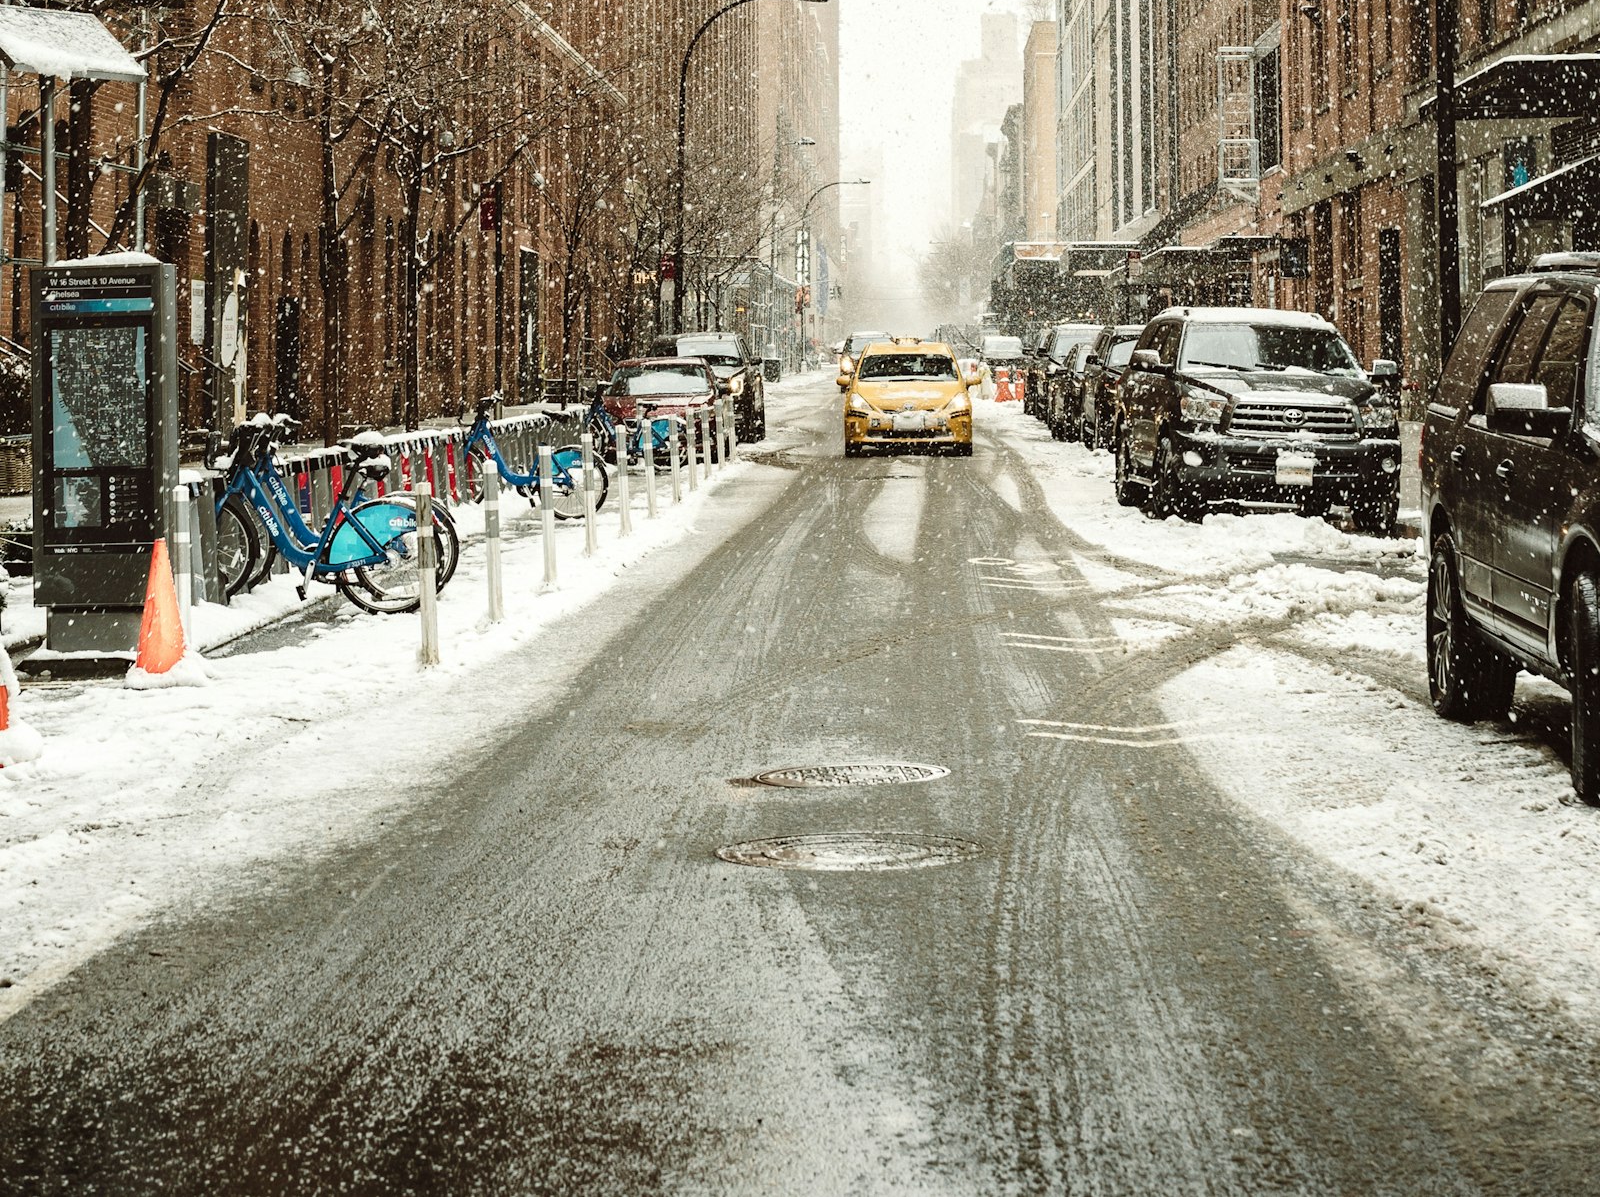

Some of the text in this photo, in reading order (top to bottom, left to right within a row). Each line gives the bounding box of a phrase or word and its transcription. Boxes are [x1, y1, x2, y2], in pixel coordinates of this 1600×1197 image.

[797, 231, 809, 285] PARK
[68, 278, 91, 286] Street
[108, 277, 136, 285] Avenue
[49, 290, 80, 298] Chelsea
